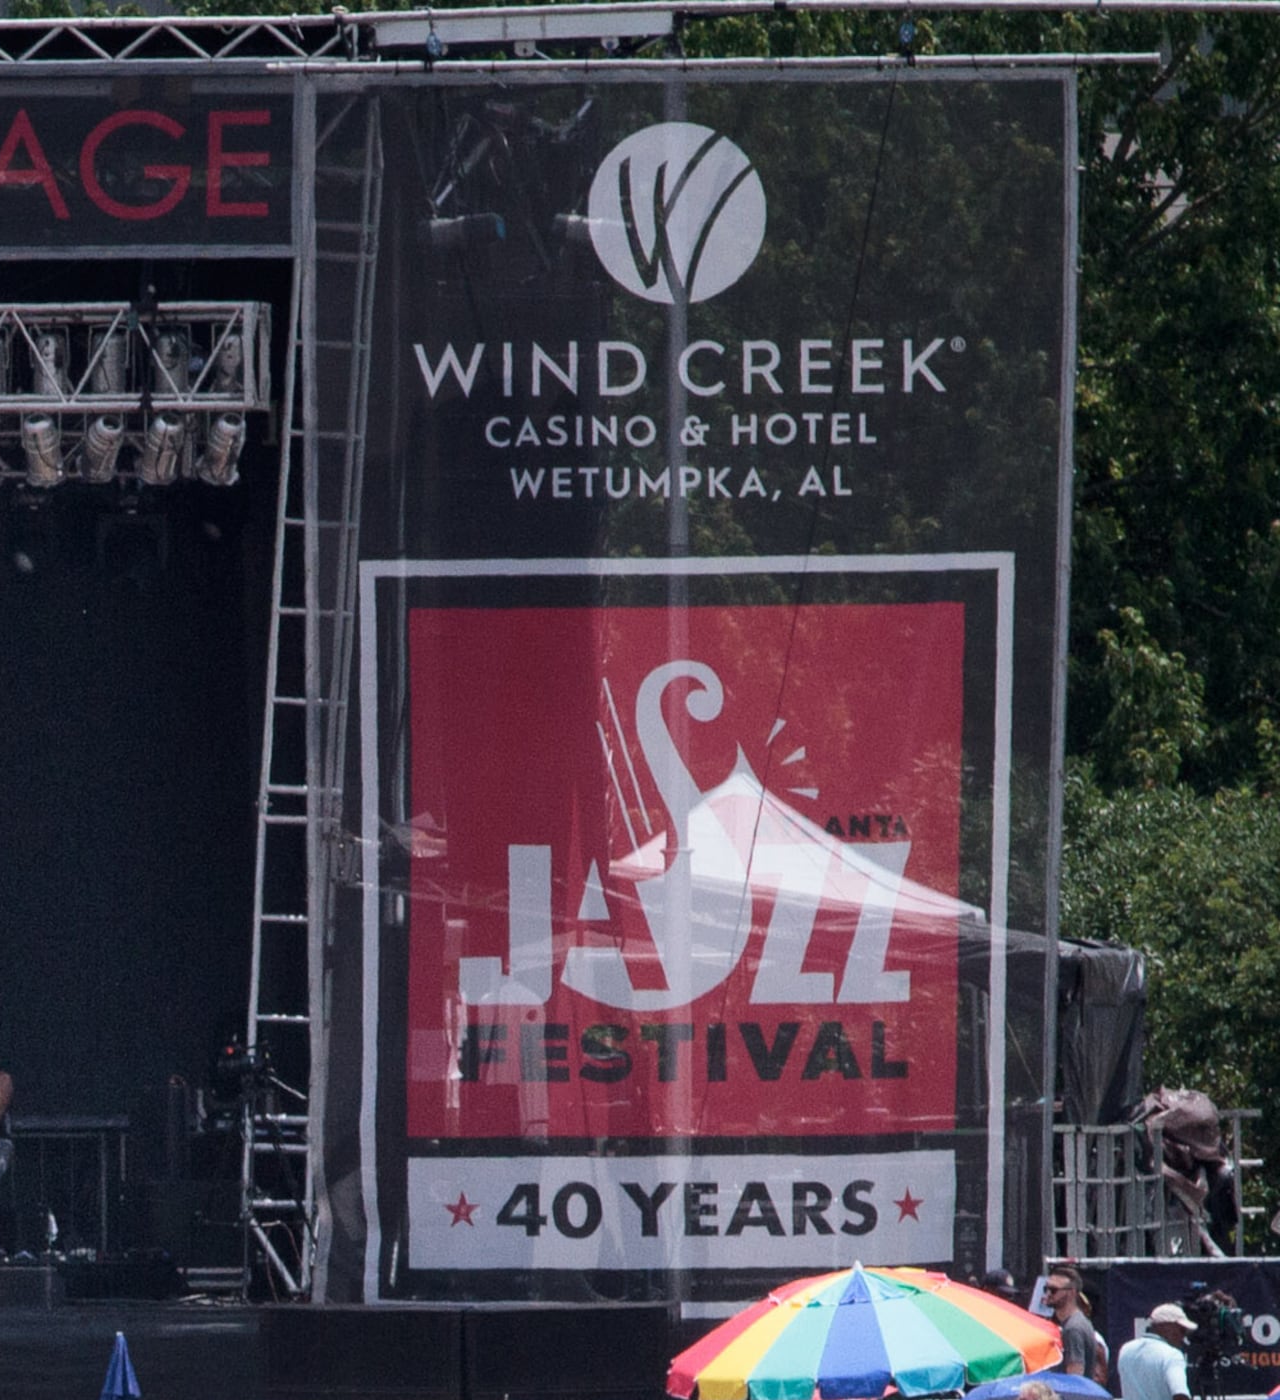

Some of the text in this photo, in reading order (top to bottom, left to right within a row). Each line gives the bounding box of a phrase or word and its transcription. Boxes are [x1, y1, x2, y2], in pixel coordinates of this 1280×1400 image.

[413, 341, 647, 399] WIND
[484, 412, 878, 448] CASINO & HOTEL
[509, 465, 853, 502] WETUMPKA, AL
[458, 840, 912, 1012] JAZZ
[458, 1020, 911, 1084] FESTIVAL
[495, 1179, 879, 1240] 40 YEARS
